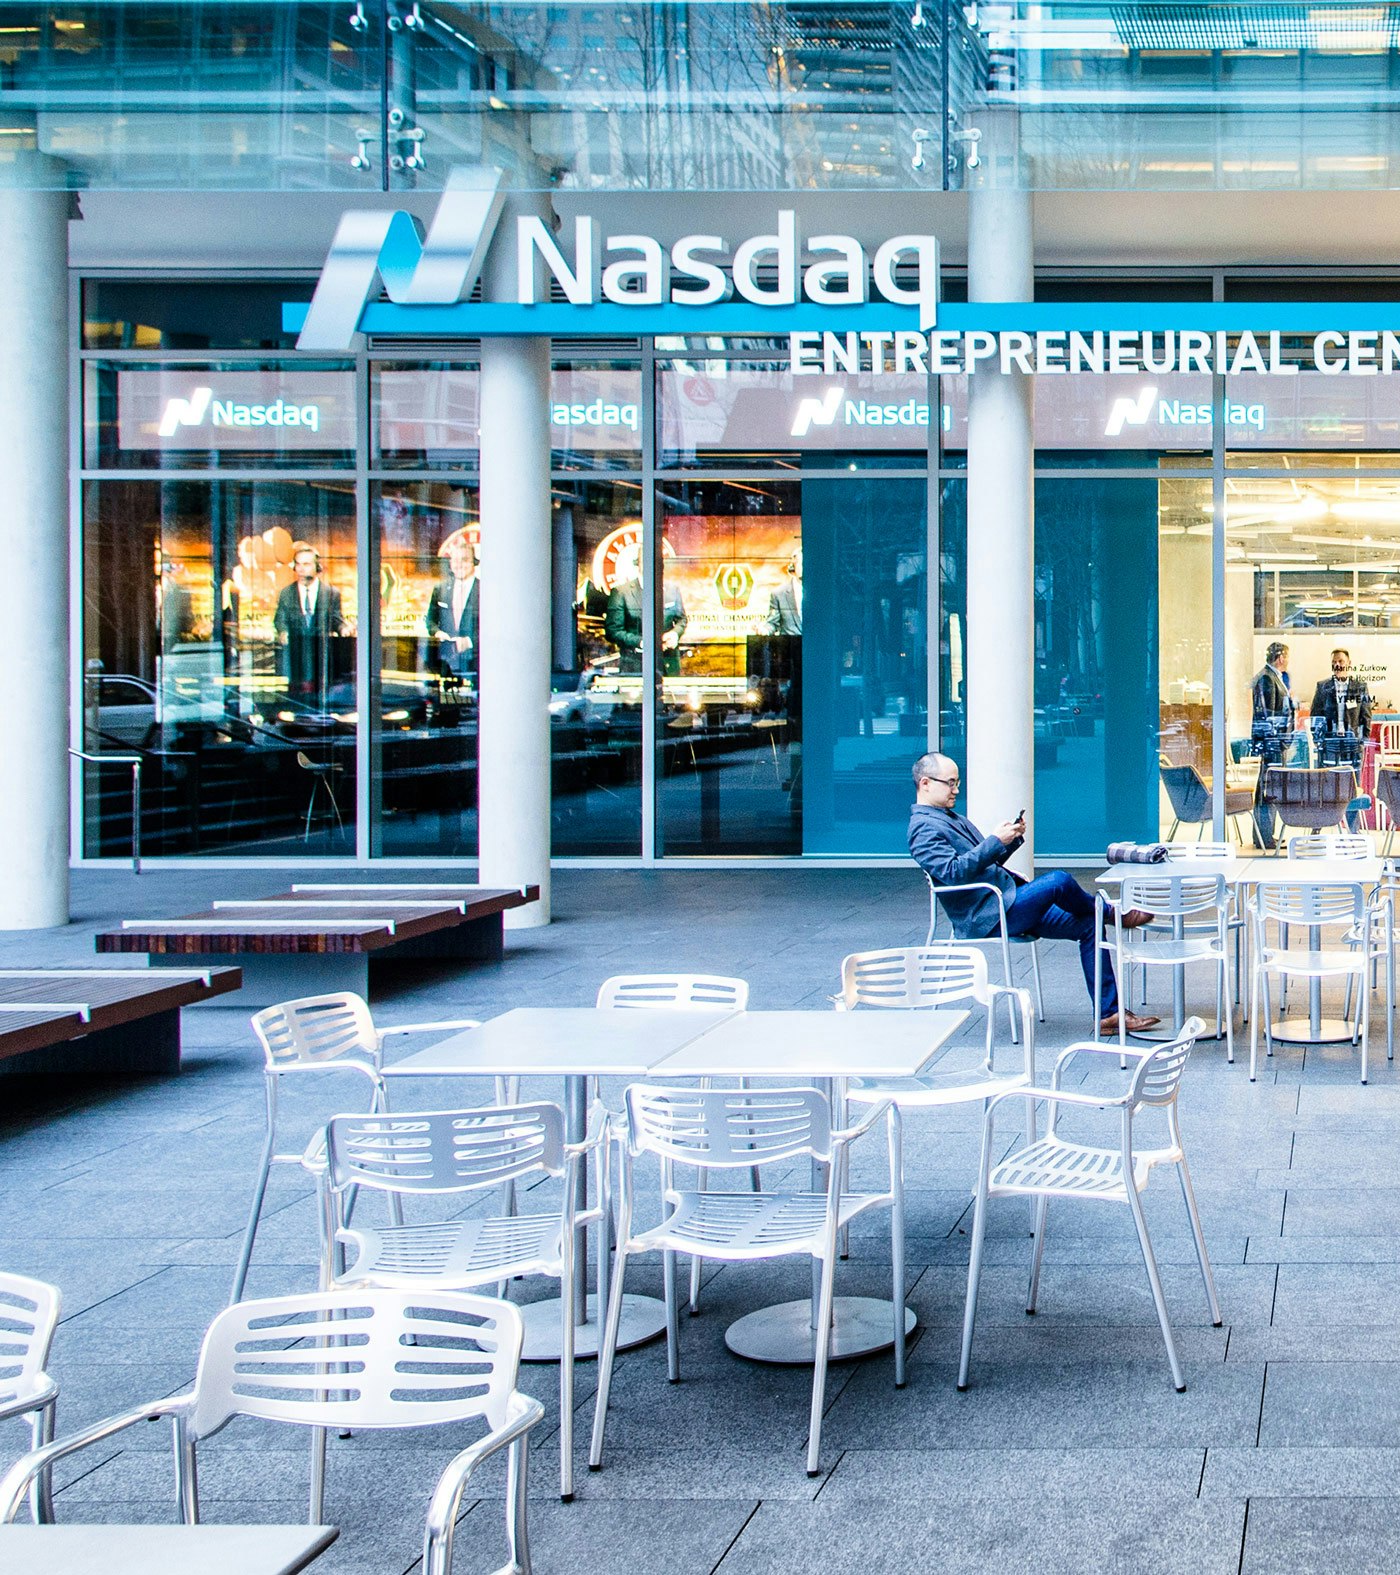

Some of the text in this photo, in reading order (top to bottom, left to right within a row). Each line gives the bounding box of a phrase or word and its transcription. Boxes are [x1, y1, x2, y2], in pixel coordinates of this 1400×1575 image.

[516, 209, 940, 332] Nasdaq
[790, 329, 1300, 375] ENTREPRENEURIAL
[212, 399, 319, 433] Nasdaq
[550, 398, 638, 431] asdaq
[687, 614, 719, 622] ATIONAL
[1331, 664, 1387, 672] Marina Zurkow
[1355, 674, 1387, 682] Horizon
[1336, 695, 1376, 704] YEBEAM
